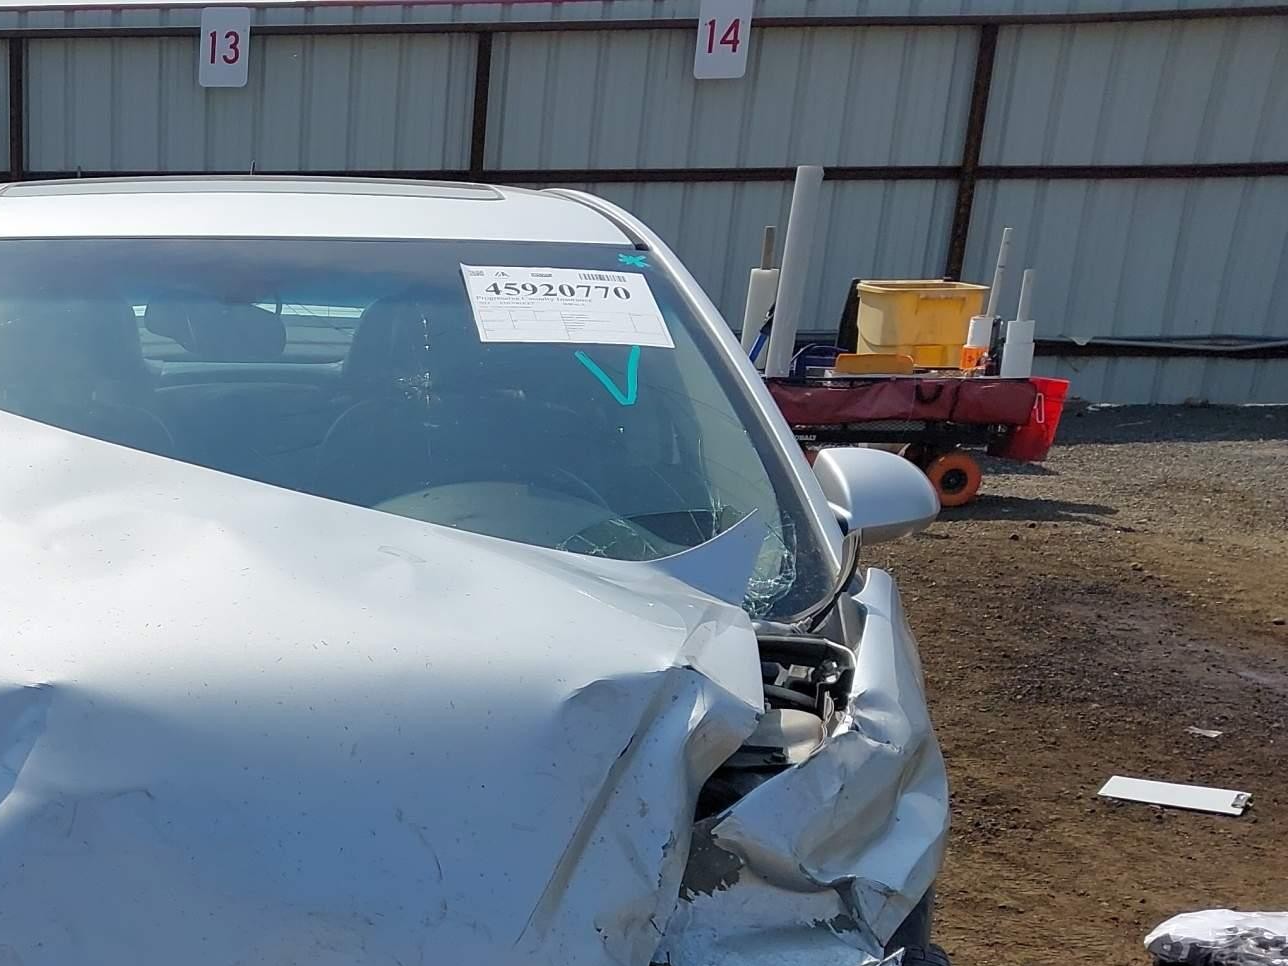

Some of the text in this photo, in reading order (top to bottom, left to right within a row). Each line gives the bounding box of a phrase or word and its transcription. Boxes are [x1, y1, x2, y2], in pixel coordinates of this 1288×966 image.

[209, 30, 240, 65] 13
[706, 17, 741, 54] 14
[484, 282, 631, 300] 45920770
